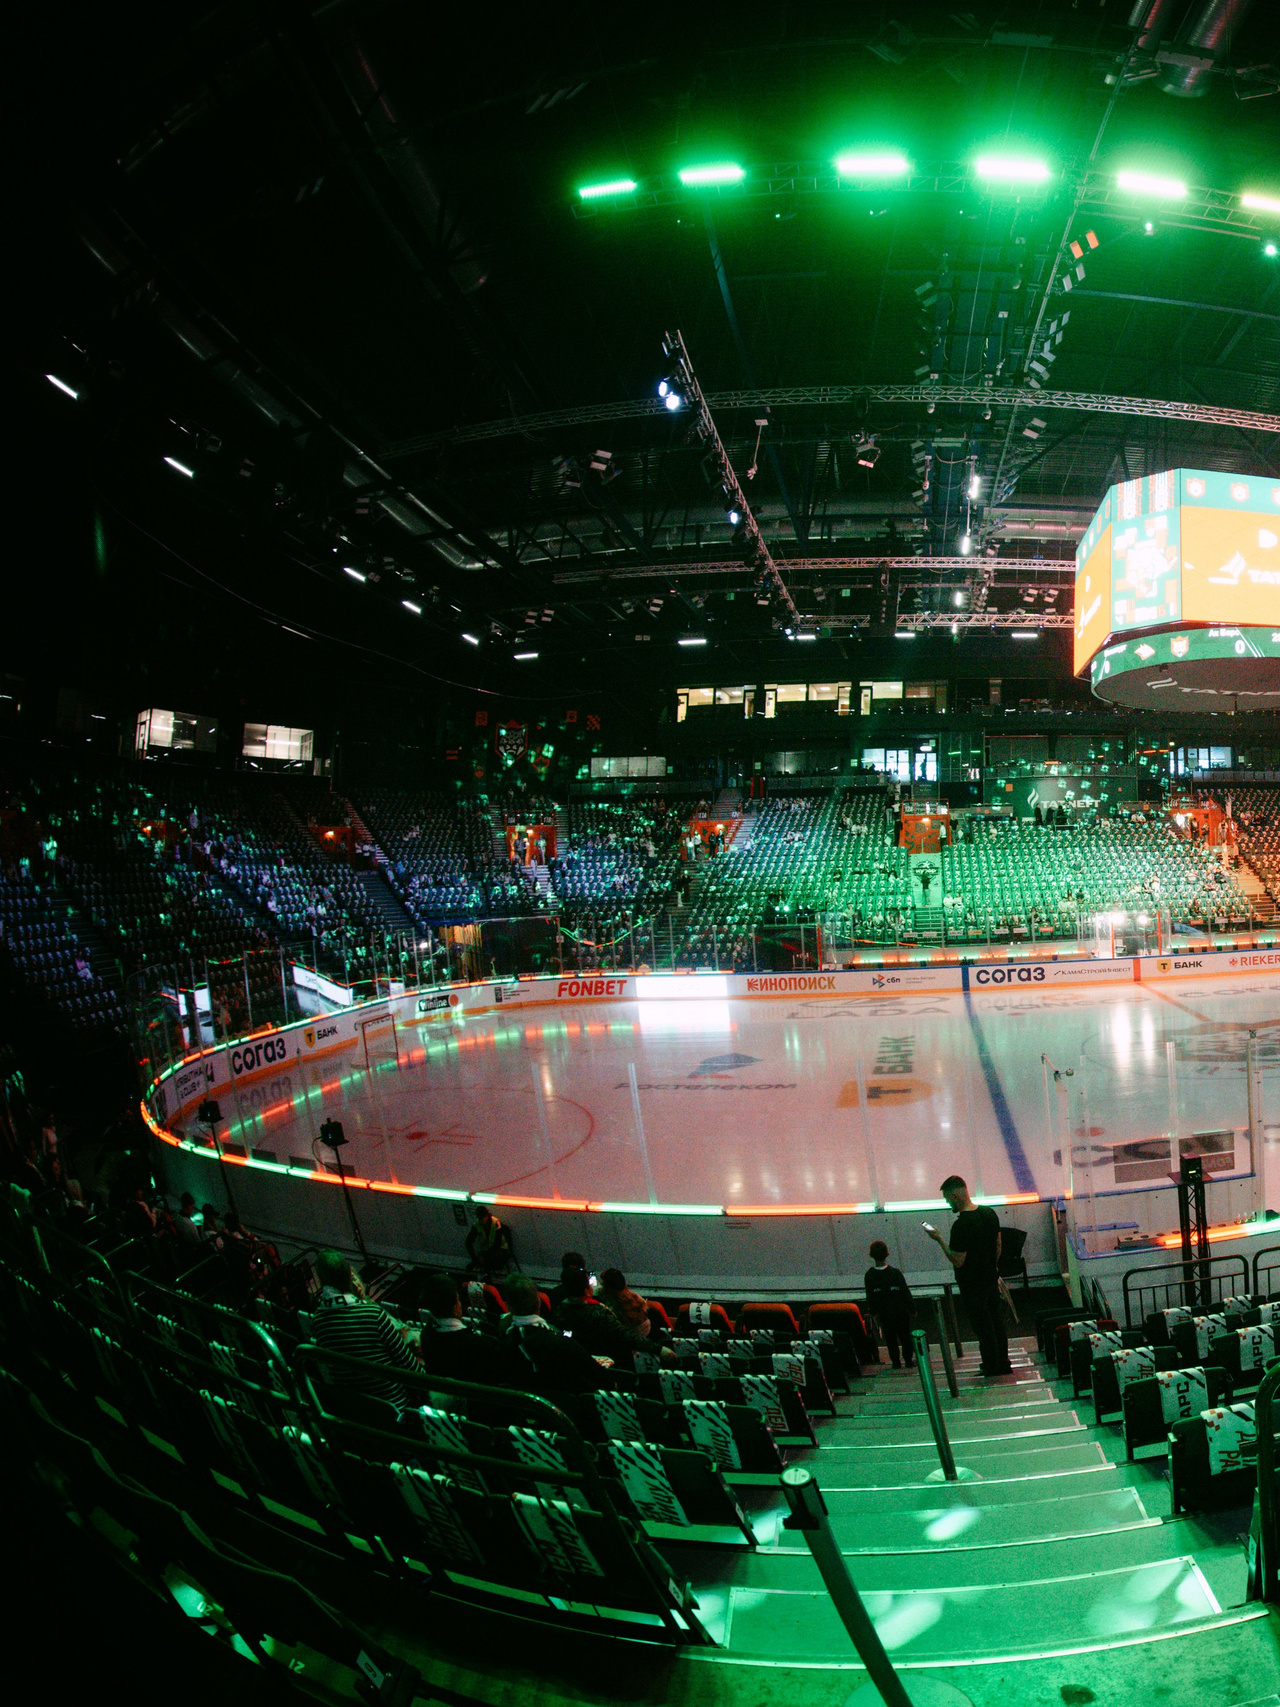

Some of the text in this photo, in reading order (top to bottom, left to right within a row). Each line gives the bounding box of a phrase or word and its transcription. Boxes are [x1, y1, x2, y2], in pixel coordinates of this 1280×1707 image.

[1235, 640, 1245, 654] 0
[1041, 800, 1102, 810] TATNEFT
[1174, 960, 1204, 970] БАНК
[976, 967, 1046, 984] согаз
[557, 980, 628, 998] FONBET
[747, 976, 836, 992] КИНОПОИСК
[786, 1007, 951, 1019] LADA
[317, 1026, 338, 1041] БАНК
[231, 1037, 287, 1075] согаз
[614, 1081, 798, 1092] Ростелеком
[1177, 1380, 1193, 1419] АРС
